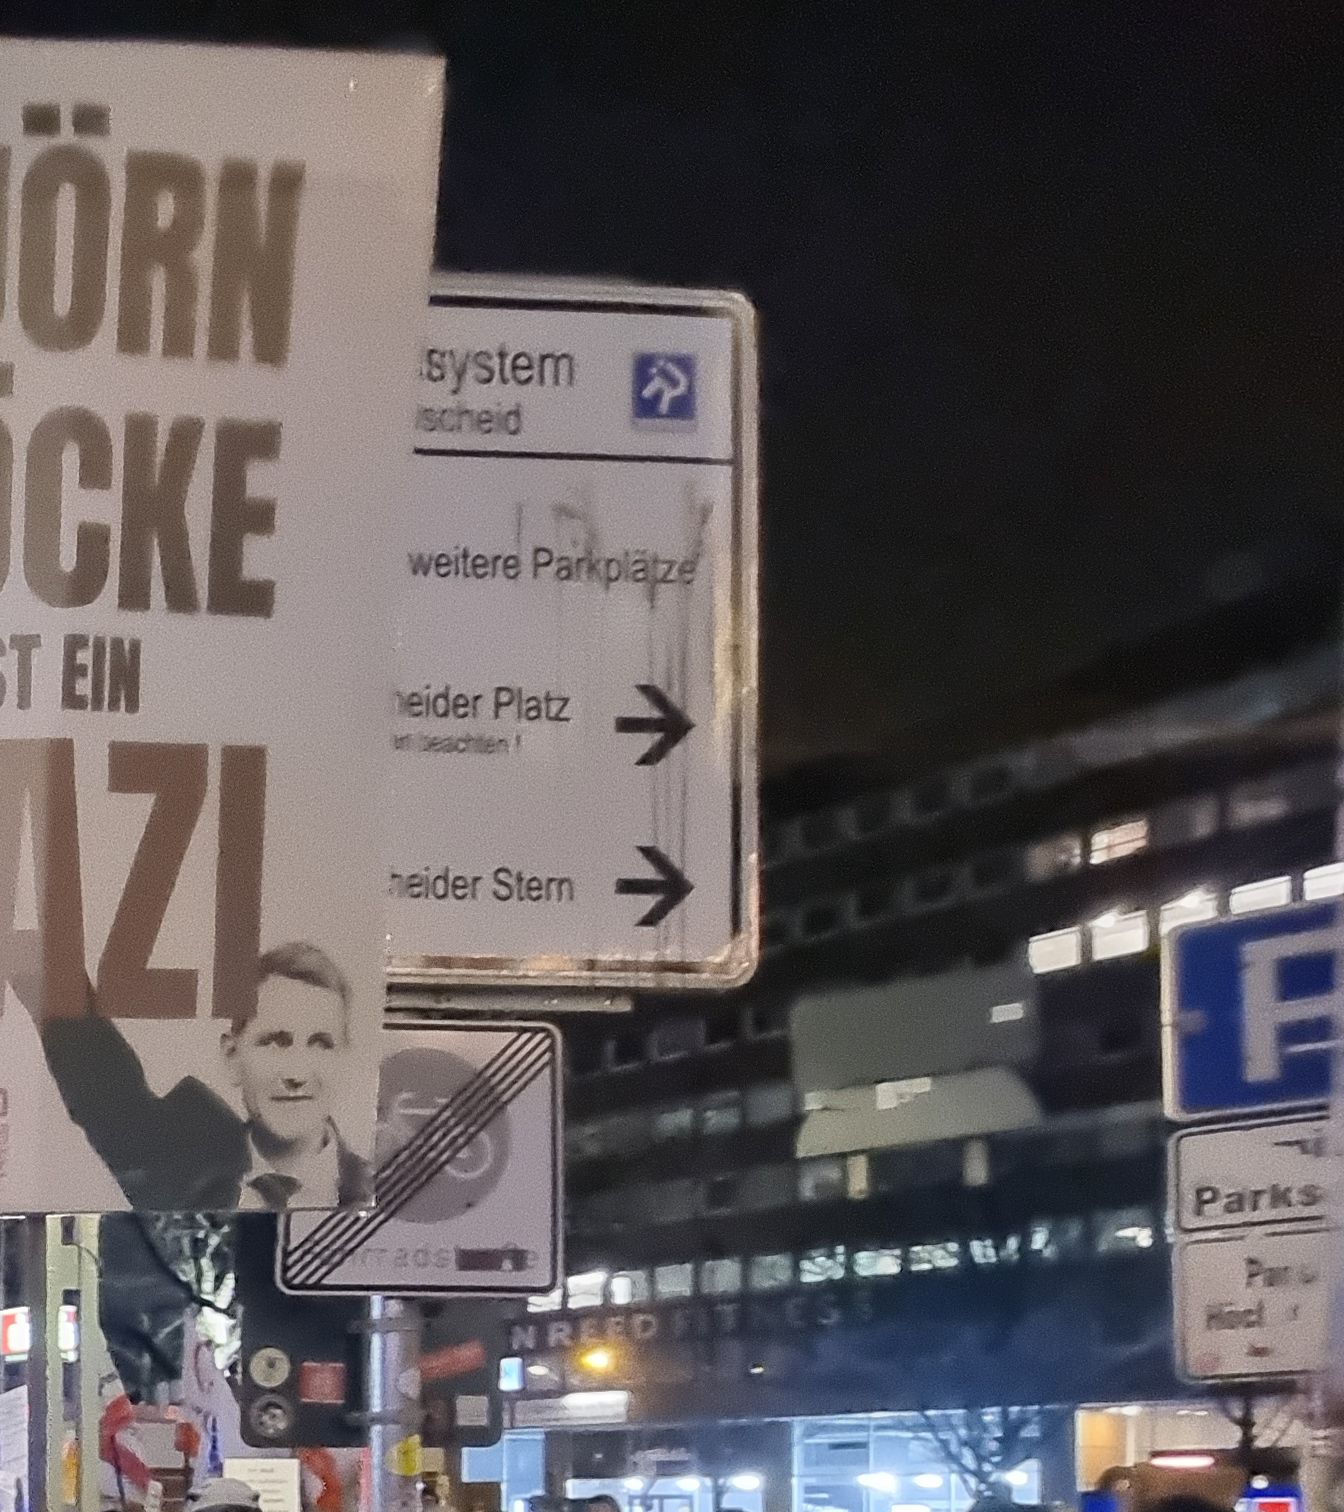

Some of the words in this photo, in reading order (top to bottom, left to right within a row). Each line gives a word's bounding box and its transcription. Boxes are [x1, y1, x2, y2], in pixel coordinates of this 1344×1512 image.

[421, 342, 577, 395] system
[408, 546, 521, 580] weitere
[532, 546, 698, 590] Parkplätze
[62, 634, 143, 715] EIN
[494, 686, 571, 723] Platz
[492, 867, 574, 903] Stern
[1194, 1183, 1324, 1217] Parks
